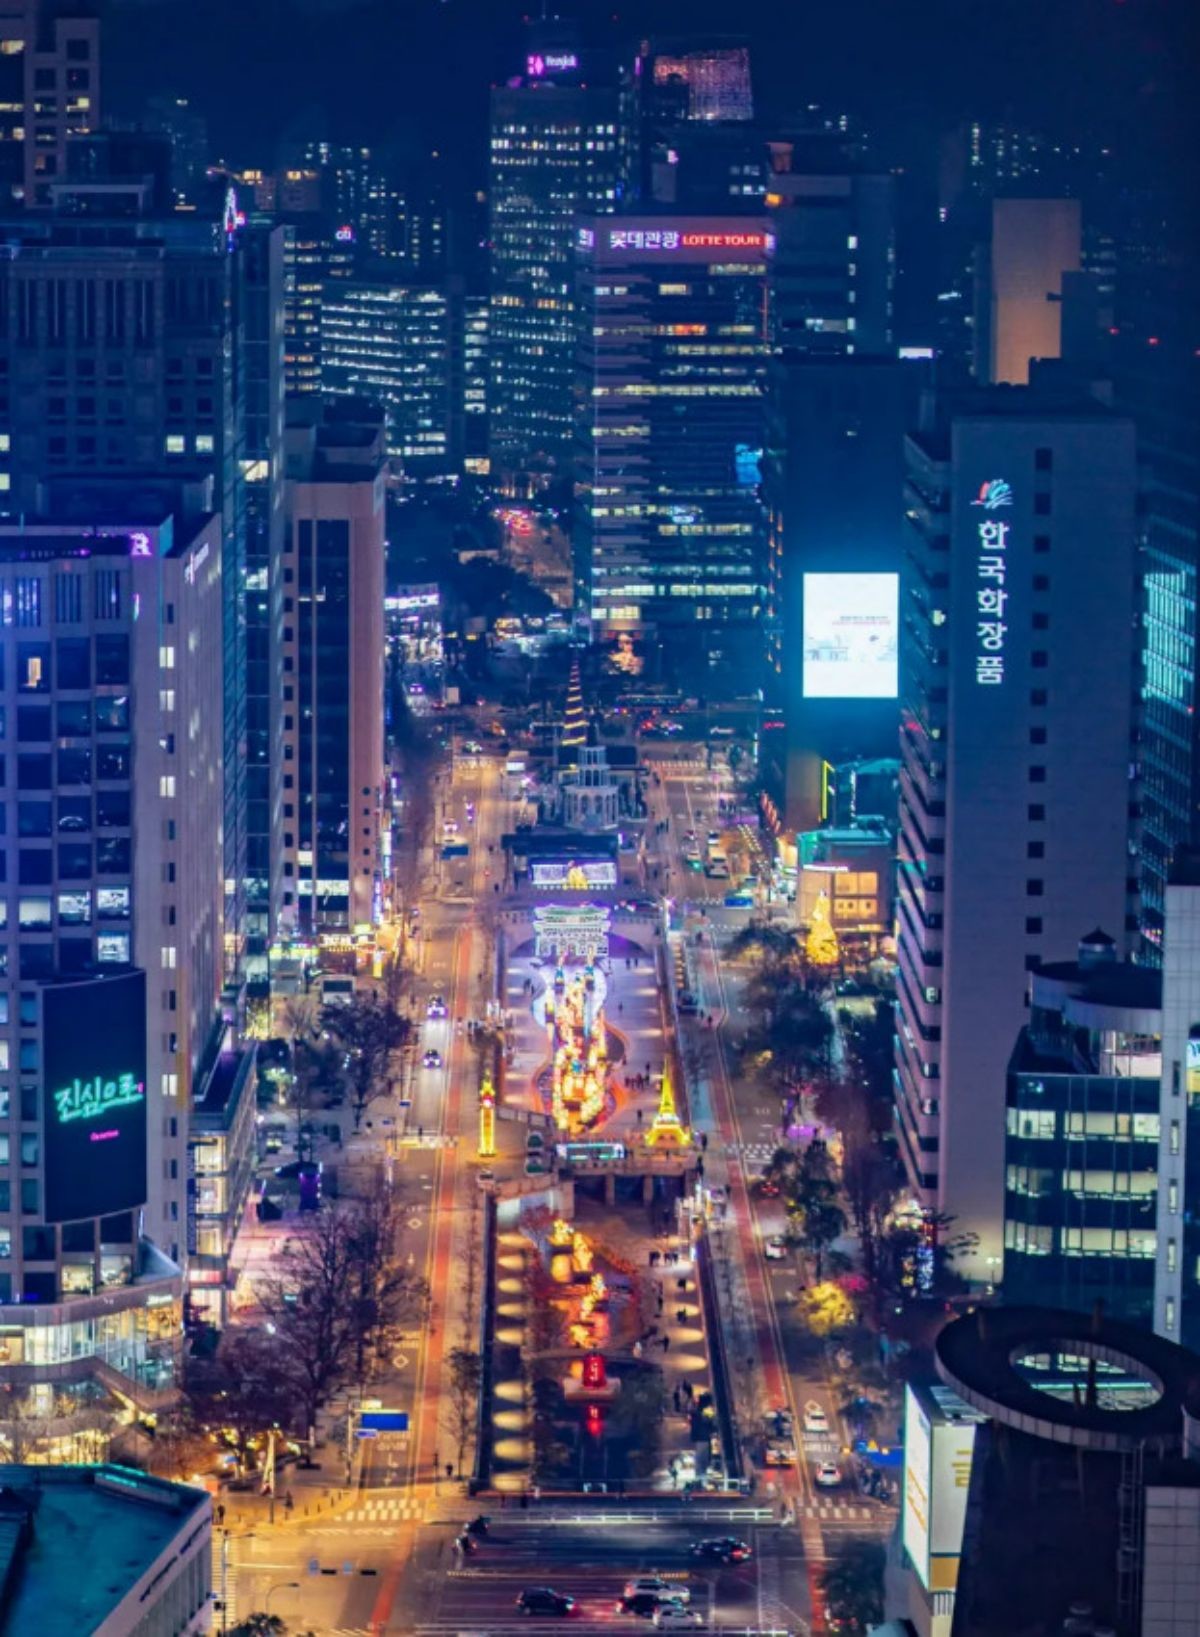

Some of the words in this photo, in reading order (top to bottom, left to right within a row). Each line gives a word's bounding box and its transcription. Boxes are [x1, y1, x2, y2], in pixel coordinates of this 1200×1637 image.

[610, 230, 679, 249] 롯데관광
[682, 234, 724, 246] LOTTE
[725, 234, 761, 246] TOUR
[976, 520, 1010, 684] 한국화장품
